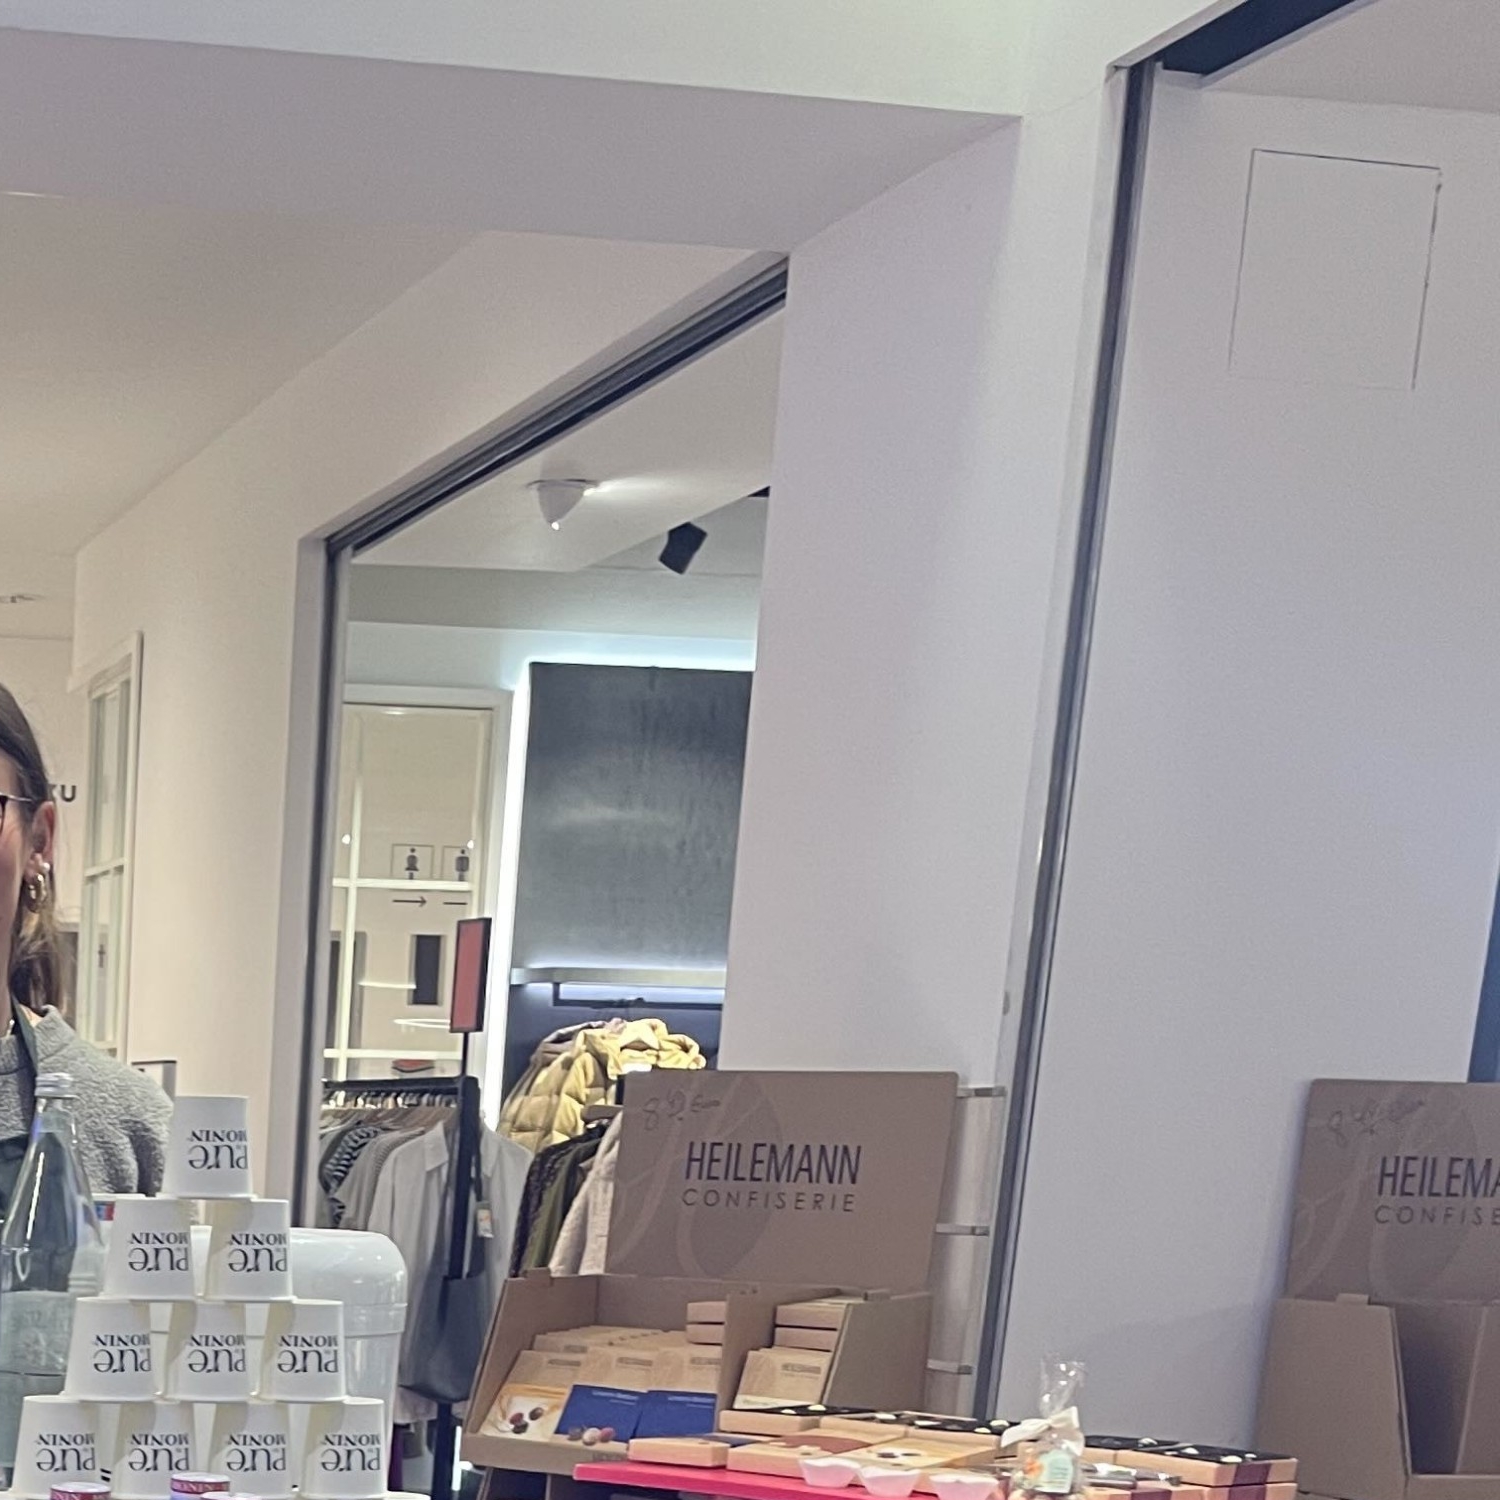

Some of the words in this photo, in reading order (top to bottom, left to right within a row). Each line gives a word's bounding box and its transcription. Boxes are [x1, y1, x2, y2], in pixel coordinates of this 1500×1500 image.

[188, 1144, 248, 1170] Pure
[685, 1140, 862, 1186] HEILEMANN
[681, 1187, 856, 1213] CONFISERIE
[128, 1246, 190, 1272] Pure
[228, 1247, 288, 1273] Pure
[93, 1349, 151, 1373] Pure
[189, 1349, 246, 1374] Pure
[278, 1349, 339, 1374] Pure
[36, 1447, 96, 1472] Pure
[129, 1447, 190, 1472] Pure
[227, 1447, 287, 1472] Pure
[321, 1448, 381, 1472] Pure
